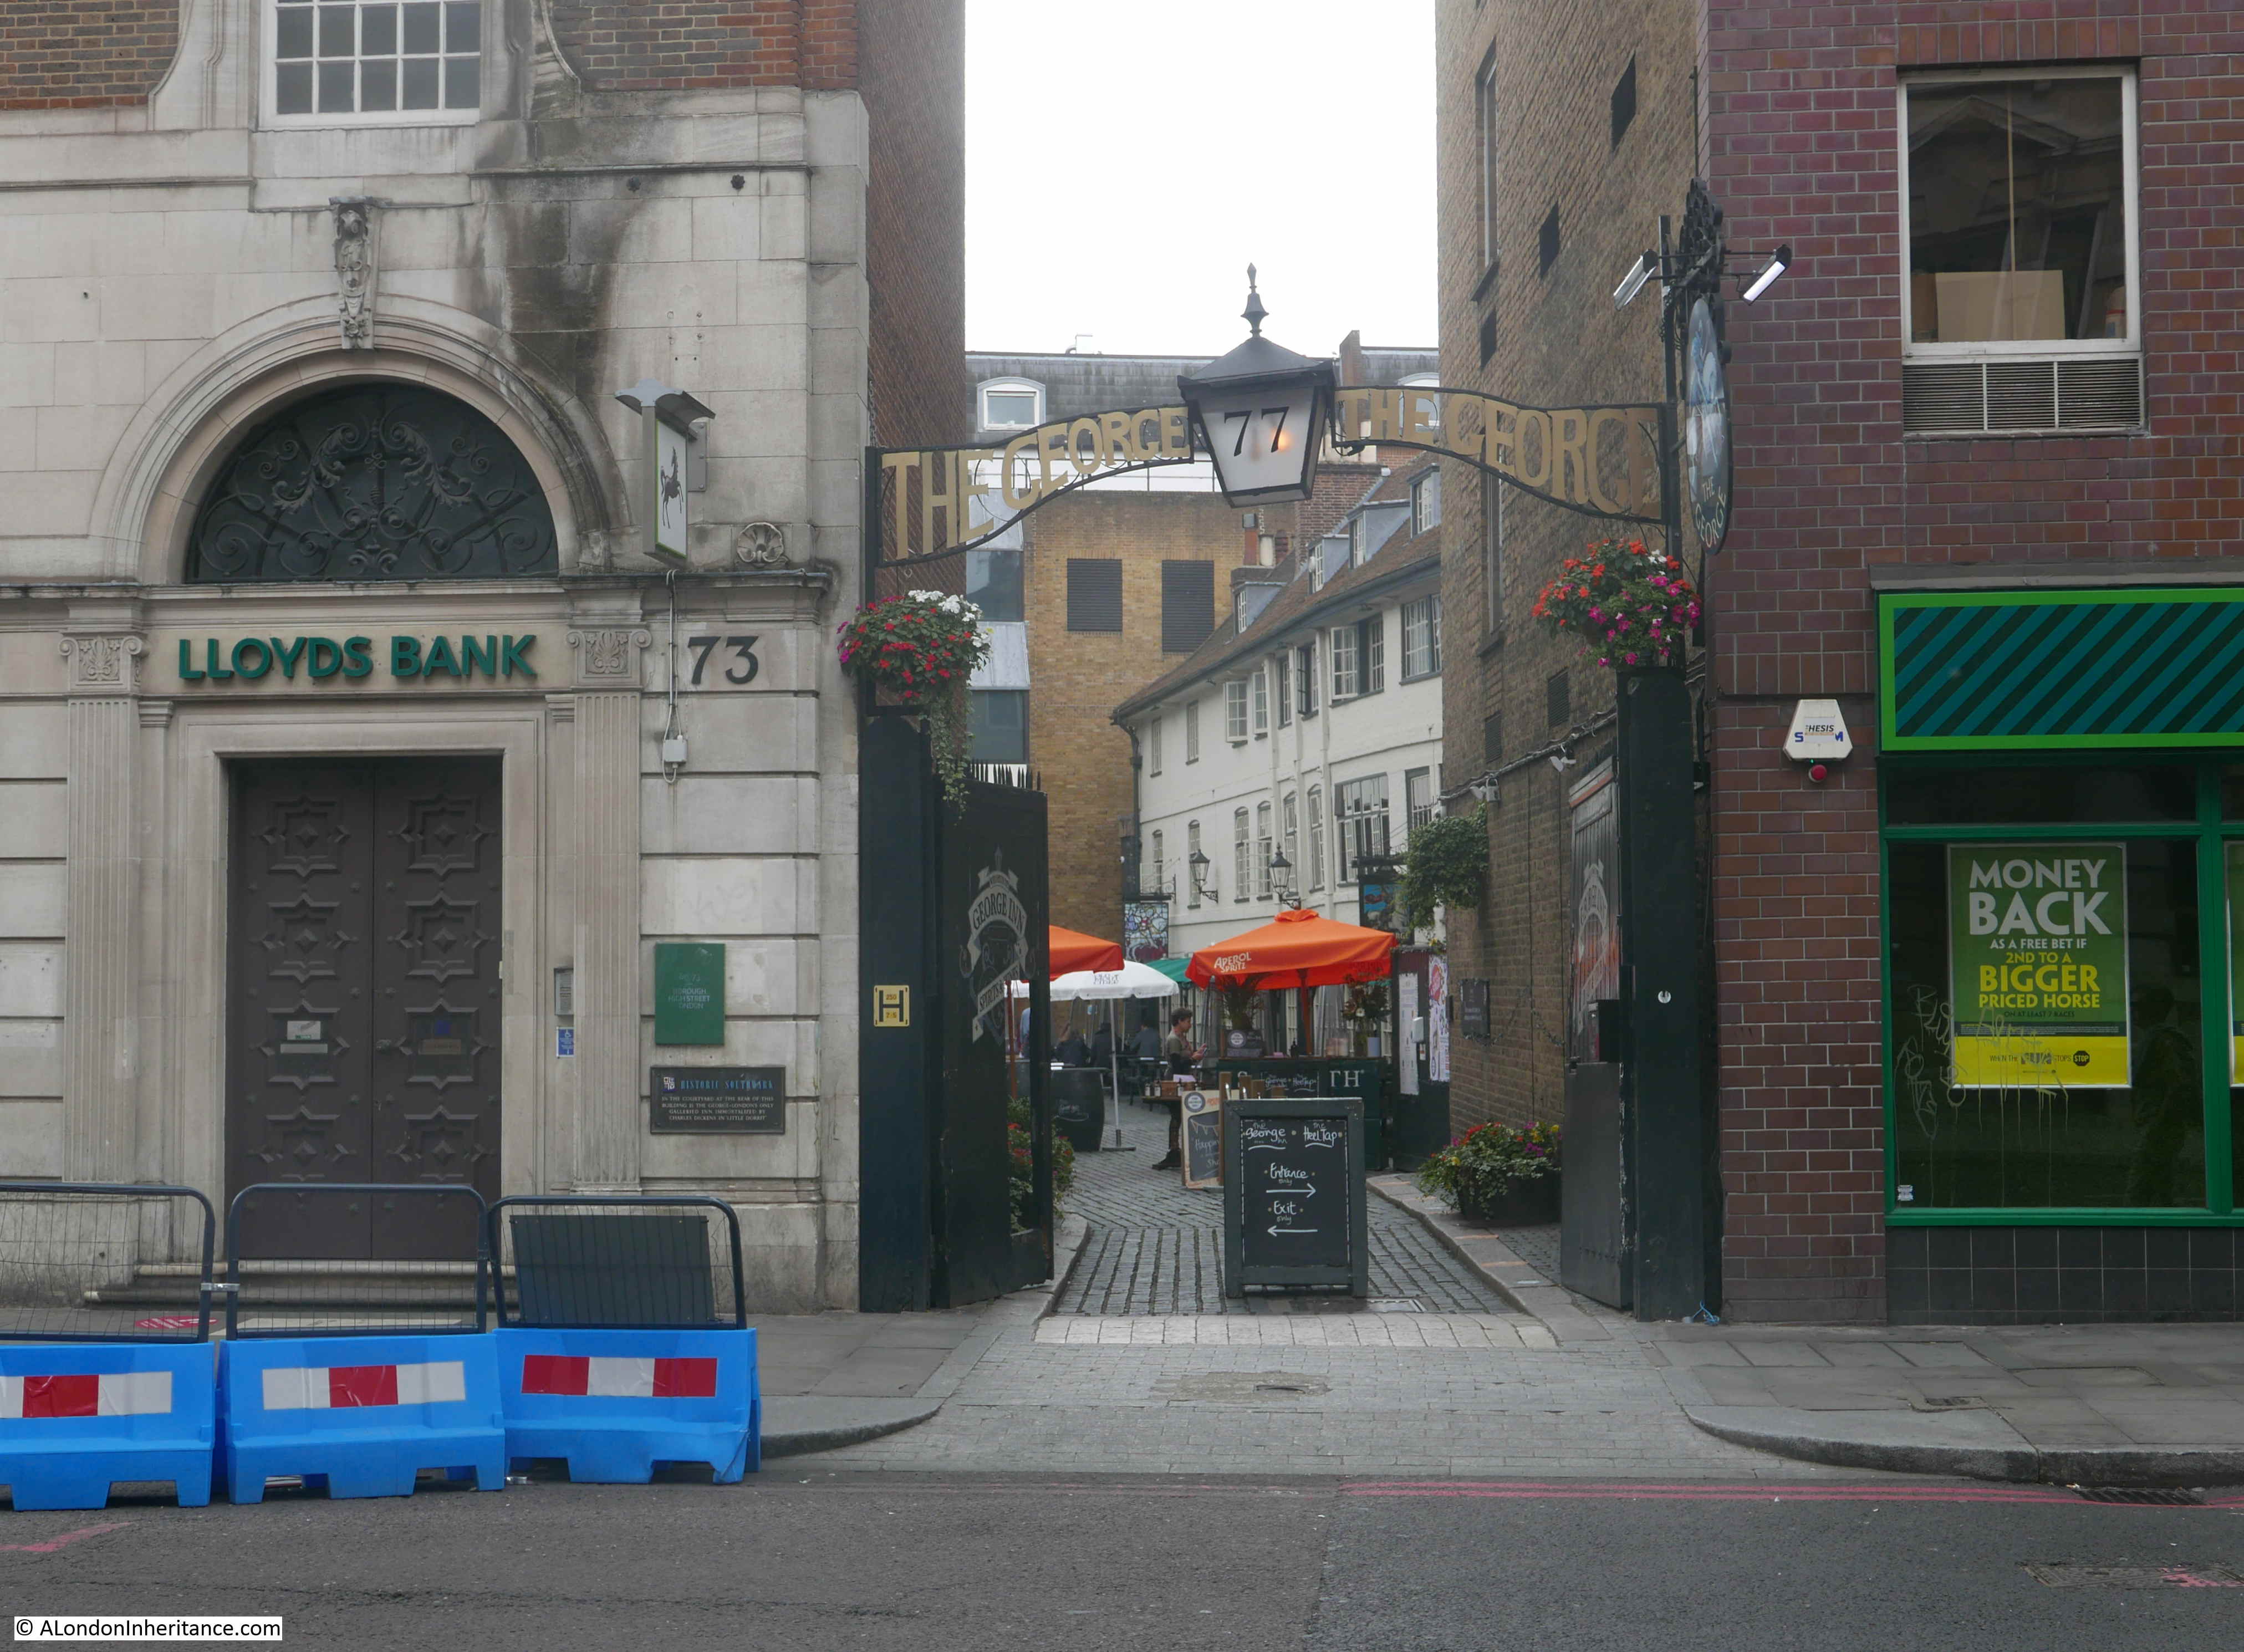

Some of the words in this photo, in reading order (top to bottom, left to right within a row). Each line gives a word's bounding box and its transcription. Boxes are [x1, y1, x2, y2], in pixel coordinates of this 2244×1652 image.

[1223, 405, 1289, 457] 77
[1335, 389, 1436, 445] THE
[1446, 393, 1662, 519] GEORGE
[882, 448, 995, 560] THE
[1001, 406, 1191, 510] GEORGE
[1702, 476, 1715, 502] THE
[1696, 486, 1726, 548] GEORGE
[178, 636, 374, 680] LLOYDS
[390, 634, 537, 676] BANK
[687, 635, 759, 685] 73
[1969, 859, 2106, 889] MONEY
[973, 892, 1007, 930] GEORGE
[1008, 898, 1022, 934] INN
[1969, 891, 2113, 935] BACK
[1990, 939, 2005, 949] AS
[2008, 939, 2017, 949] A
[2021, 939, 2048, 949] FREE
[2052, 939, 2073, 949] BET
[2077, 939, 2087, 949] IF
[2006, 952, 2036, 963] 2ND
[2038, 952, 2058, 963] TO
[2062, 952, 2072, 963] A
[1214, 951, 1252, 969] APEROL
[1220, 962, 1246, 973] SPRITZ
[1980, 965, 2101, 992] BIGGER
[879, 990, 904, 1023] H
[1978, 993, 2038, 1008] PRICED
[2043, 993, 2100, 1008] HORSE
[680, 1080, 719, 1090] HISTORIC
[725, 1080, 773, 1090] SOUTHWARK
[1320, 1128, 1337, 1146] Tap
[1270, 1162, 1309, 1179] Entrance
[1273, 1200, 1297, 1215] Exit
